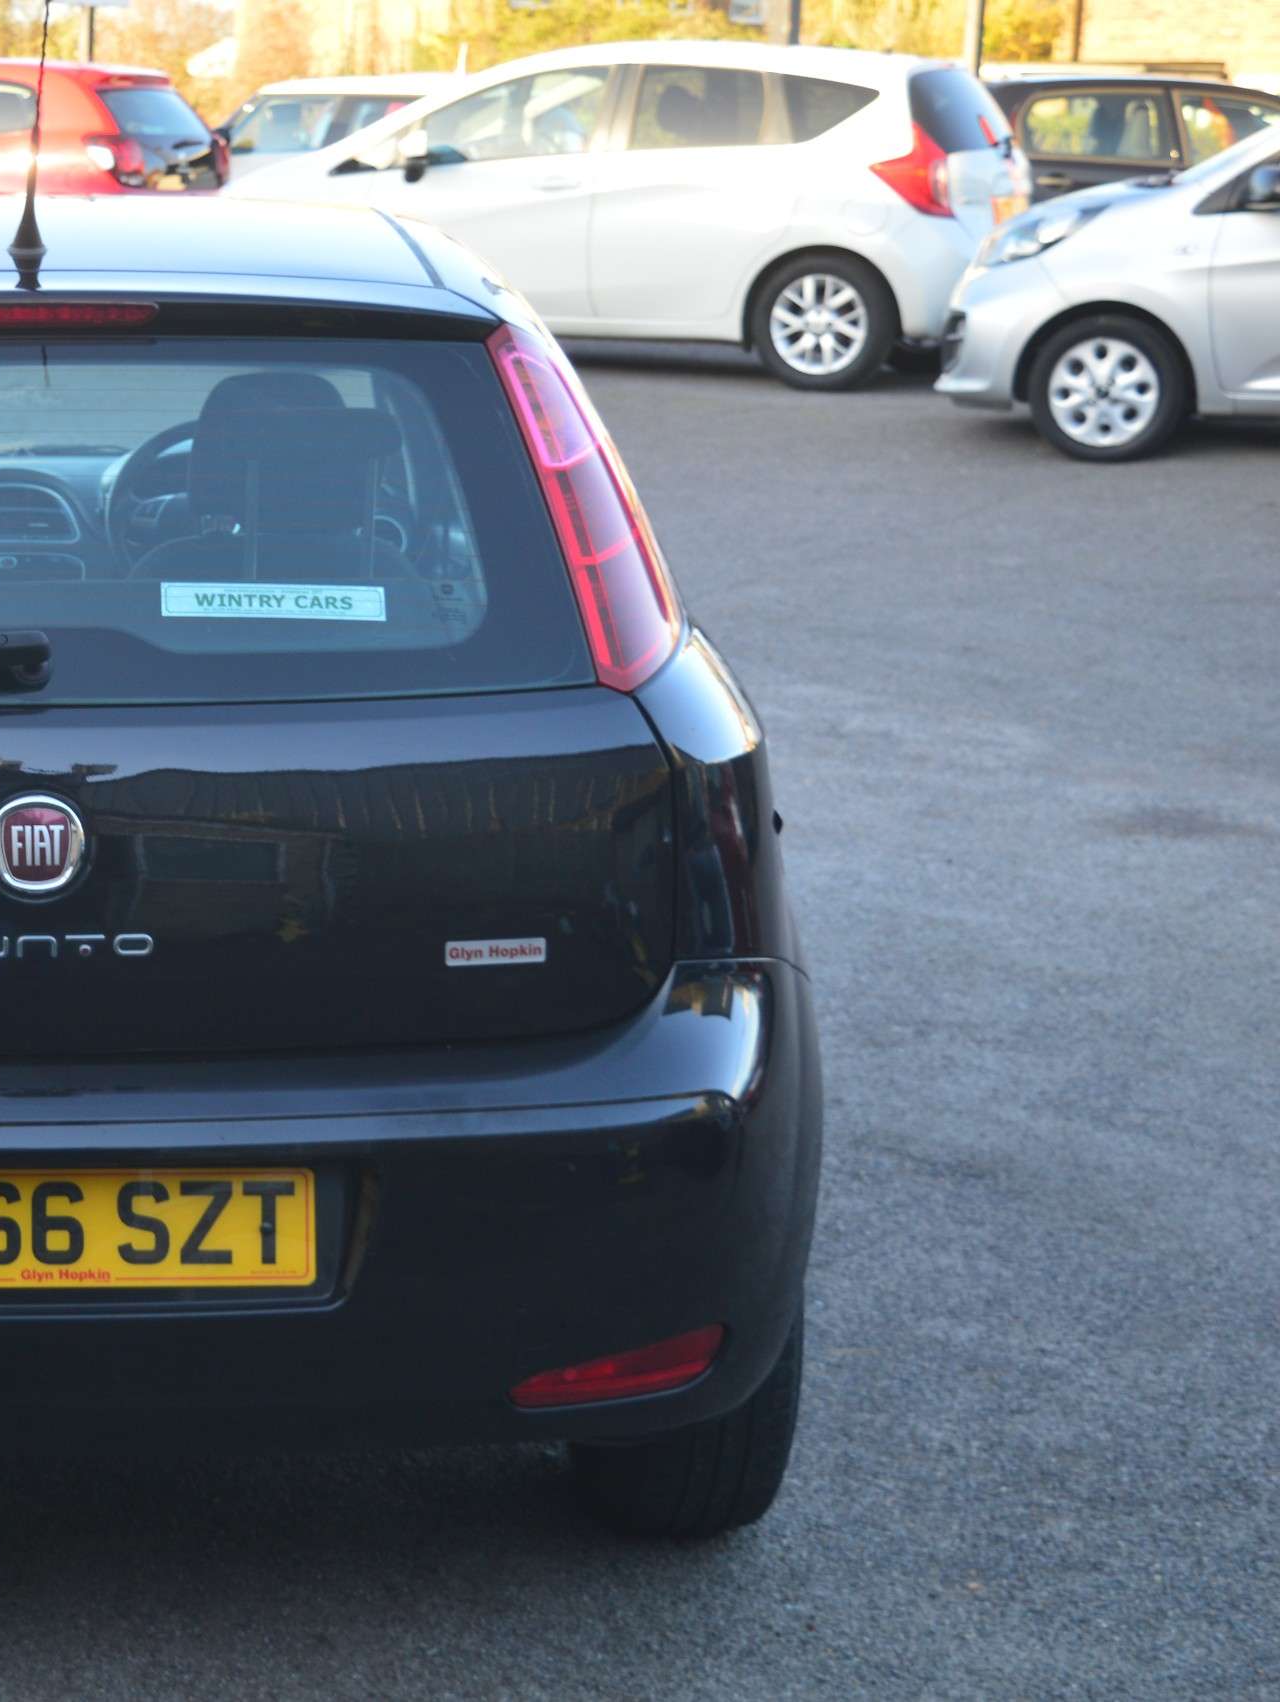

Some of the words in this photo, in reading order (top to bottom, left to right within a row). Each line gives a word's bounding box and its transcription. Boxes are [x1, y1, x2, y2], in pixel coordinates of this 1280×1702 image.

[194, 593, 286, 609] WINTRY
[294, 595, 354, 610] CARS
[11, 824, 65, 867] FIAT
[448, 946, 484, 961] Glyn
[488, 944, 542, 958] Hopkin
[117, 1180, 295, 1265] SZT
[20, 1268, 53, 1282] Glyn
[58, 1268, 111, 1282] Hopkin
